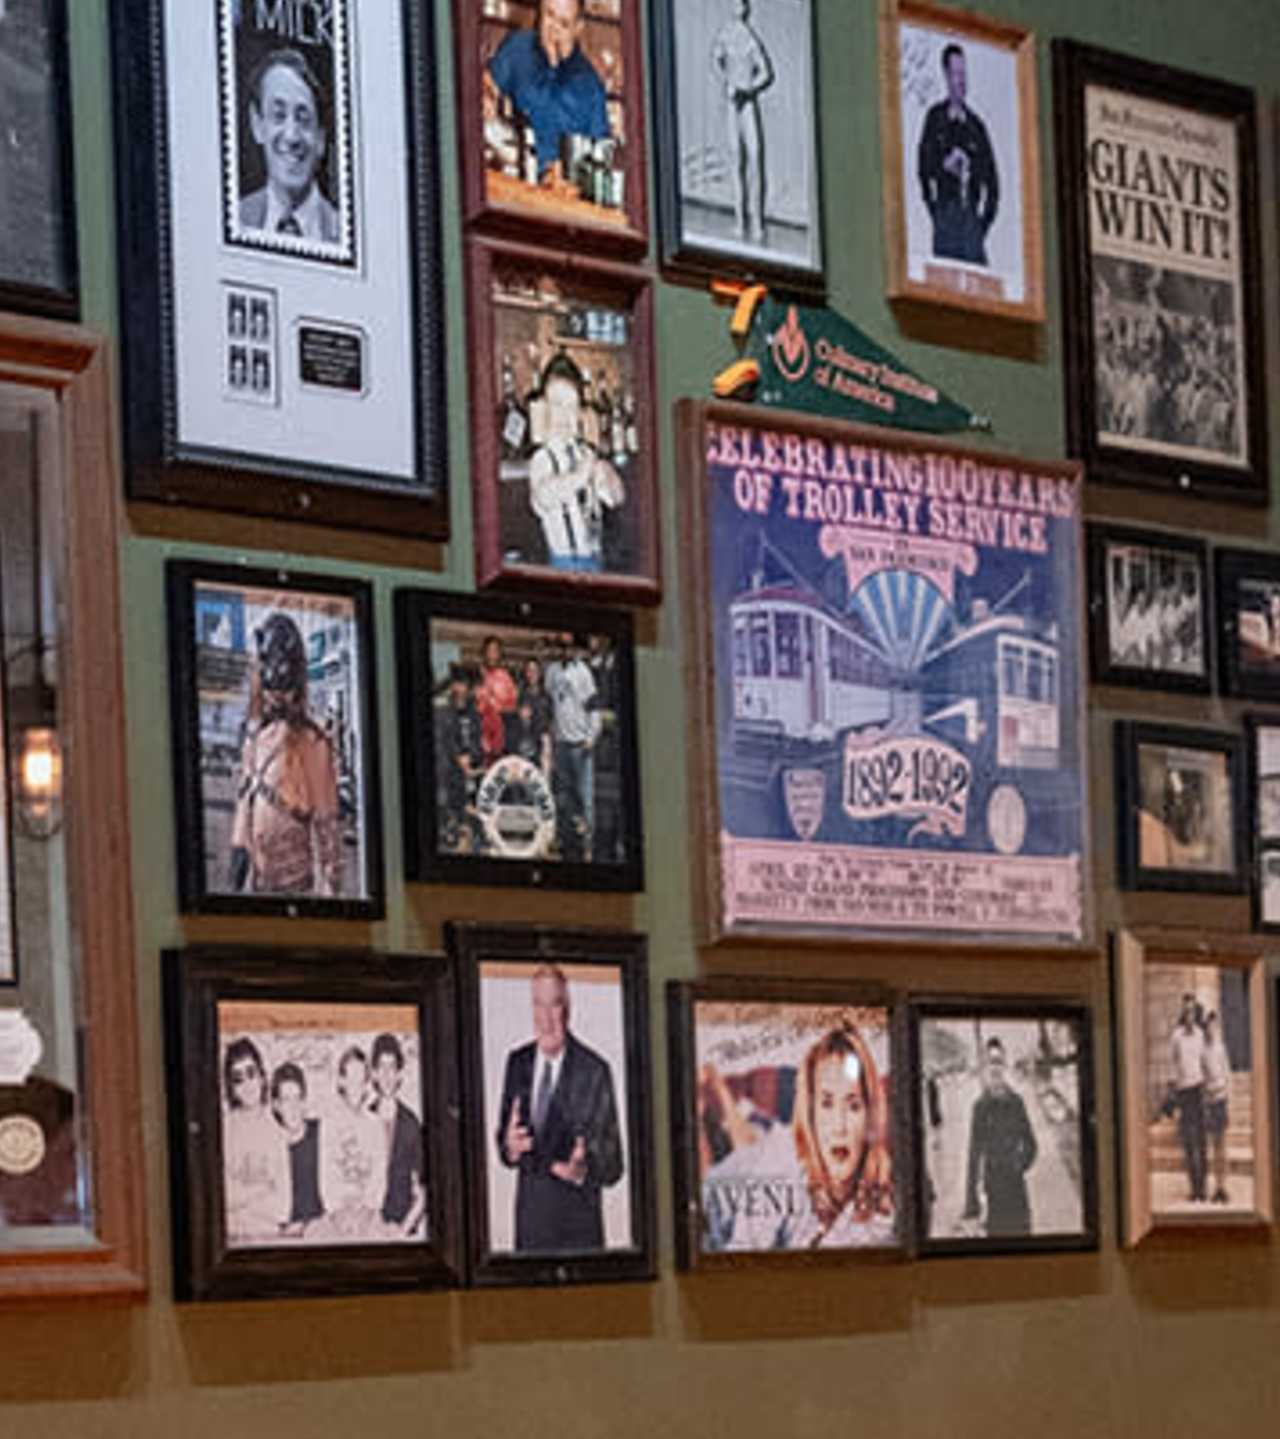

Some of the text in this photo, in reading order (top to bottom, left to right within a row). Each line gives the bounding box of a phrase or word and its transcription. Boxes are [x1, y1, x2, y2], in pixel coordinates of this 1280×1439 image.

[1090, 137, 1229, 212] GIANTS
[1094, 188, 1231, 260] WIN IT!
[733, 469, 1048, 553] OF TROLLEY SERVICE
[925, 452, 981, 500] 100
[980, 465, 1072, 518] YEARS
[848, 748, 968, 814] 1892-1992
